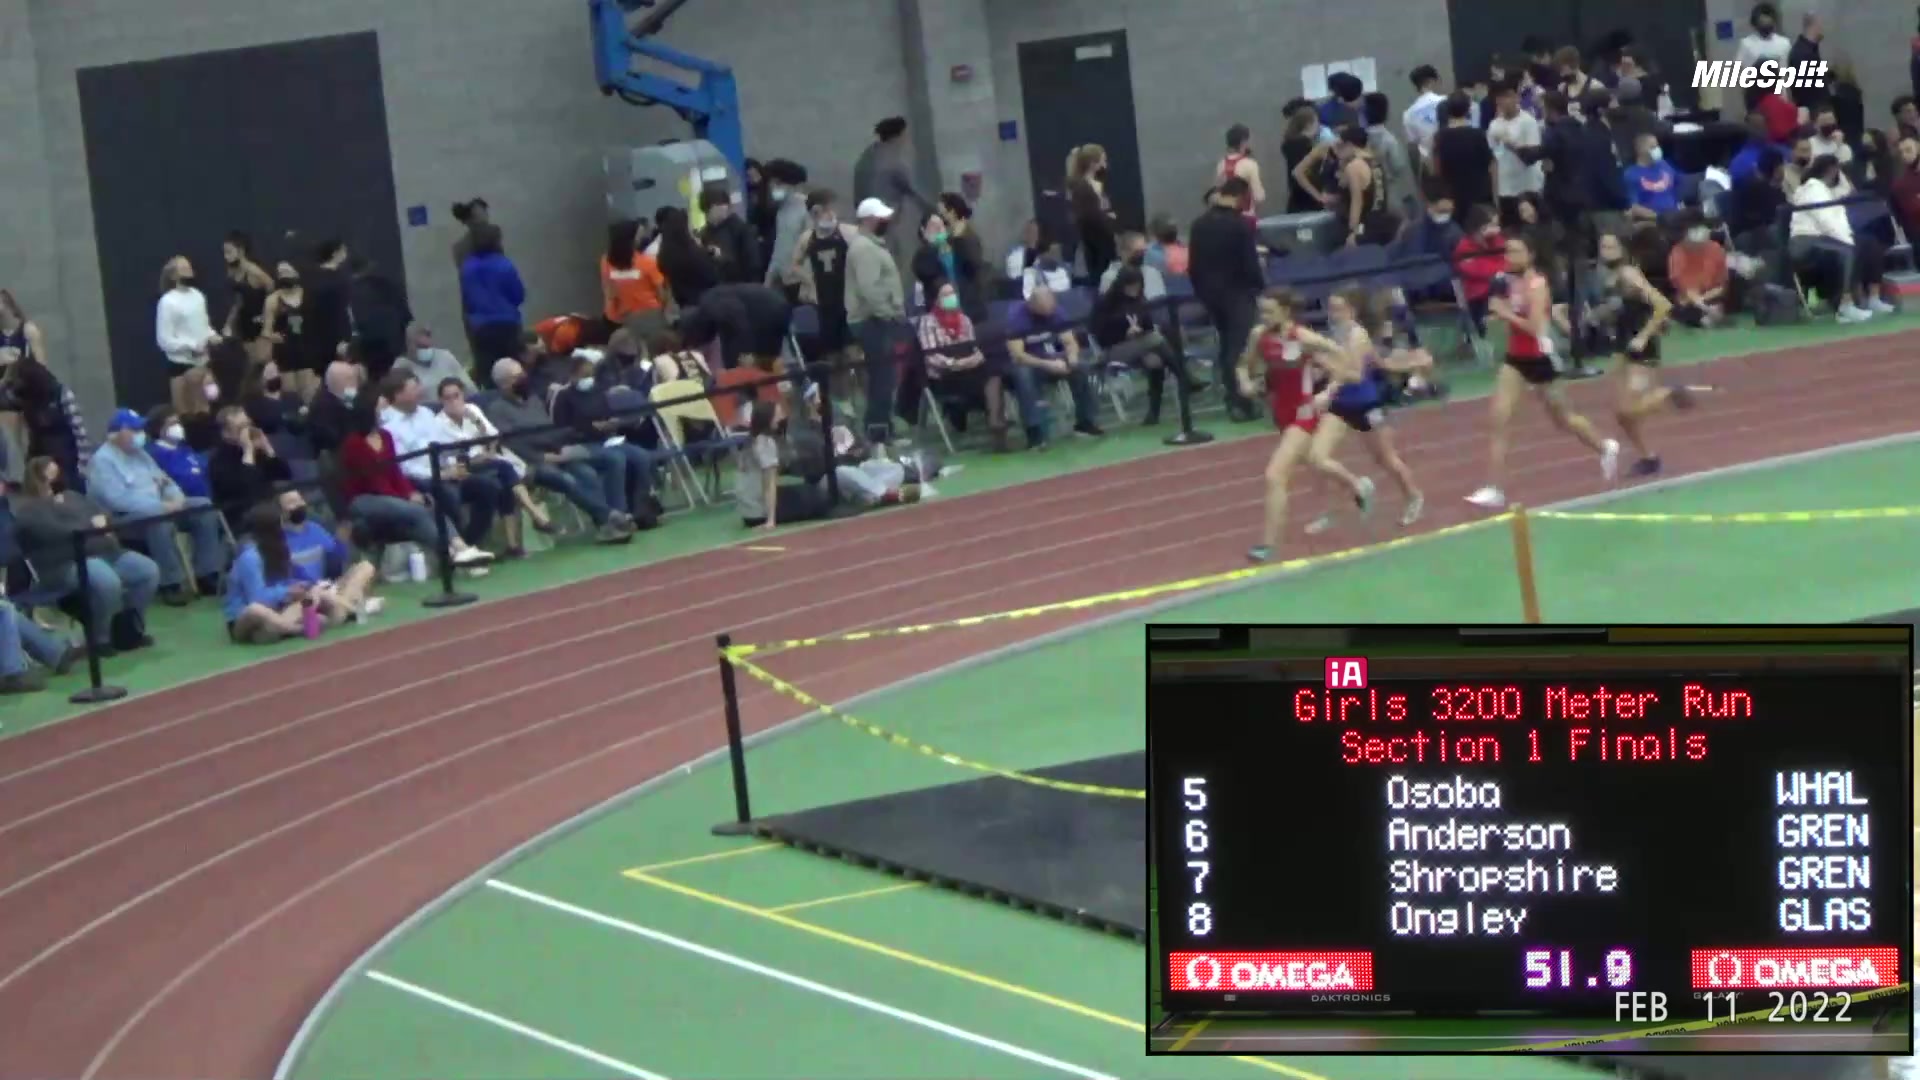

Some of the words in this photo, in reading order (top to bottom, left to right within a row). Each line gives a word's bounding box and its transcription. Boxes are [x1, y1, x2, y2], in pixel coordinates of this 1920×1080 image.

[1295, 687, 1408, 721] Girls
[1432, 686, 1522, 720] 3200
[1545, 685, 1659, 719] Meter
[1683, 684, 1753, 718] Run
[1341, 730, 1500, 763] Section
[1528, 728, 1542, 761] 1
[1569, 726, 1707, 761] Finals
[1183, 777, 1208, 811] 5
[1387, 774, 1501, 809] Osoba
[1776, 771, 1869, 806] WHAL
[1184, 819, 1209, 852] 6
[1388, 817, 1571, 851] Anderson
[1777, 813, 1870, 847] GREN
[1186, 860, 1210, 894] 7
[1389, 858, 1618, 893] Shropshire
[1778, 855, 1871, 889] GREN
[1188, 902, 1212, 935] 8
[1391, 901, 1528, 935] Ongley
[1779, 897, 1872, 931] GLAS
[1231, 961, 1355, 989] OMEGA
[1753, 957, 1880, 985] OMEGA
[1310, 993, 1391, 1003] DAKTRONICS
